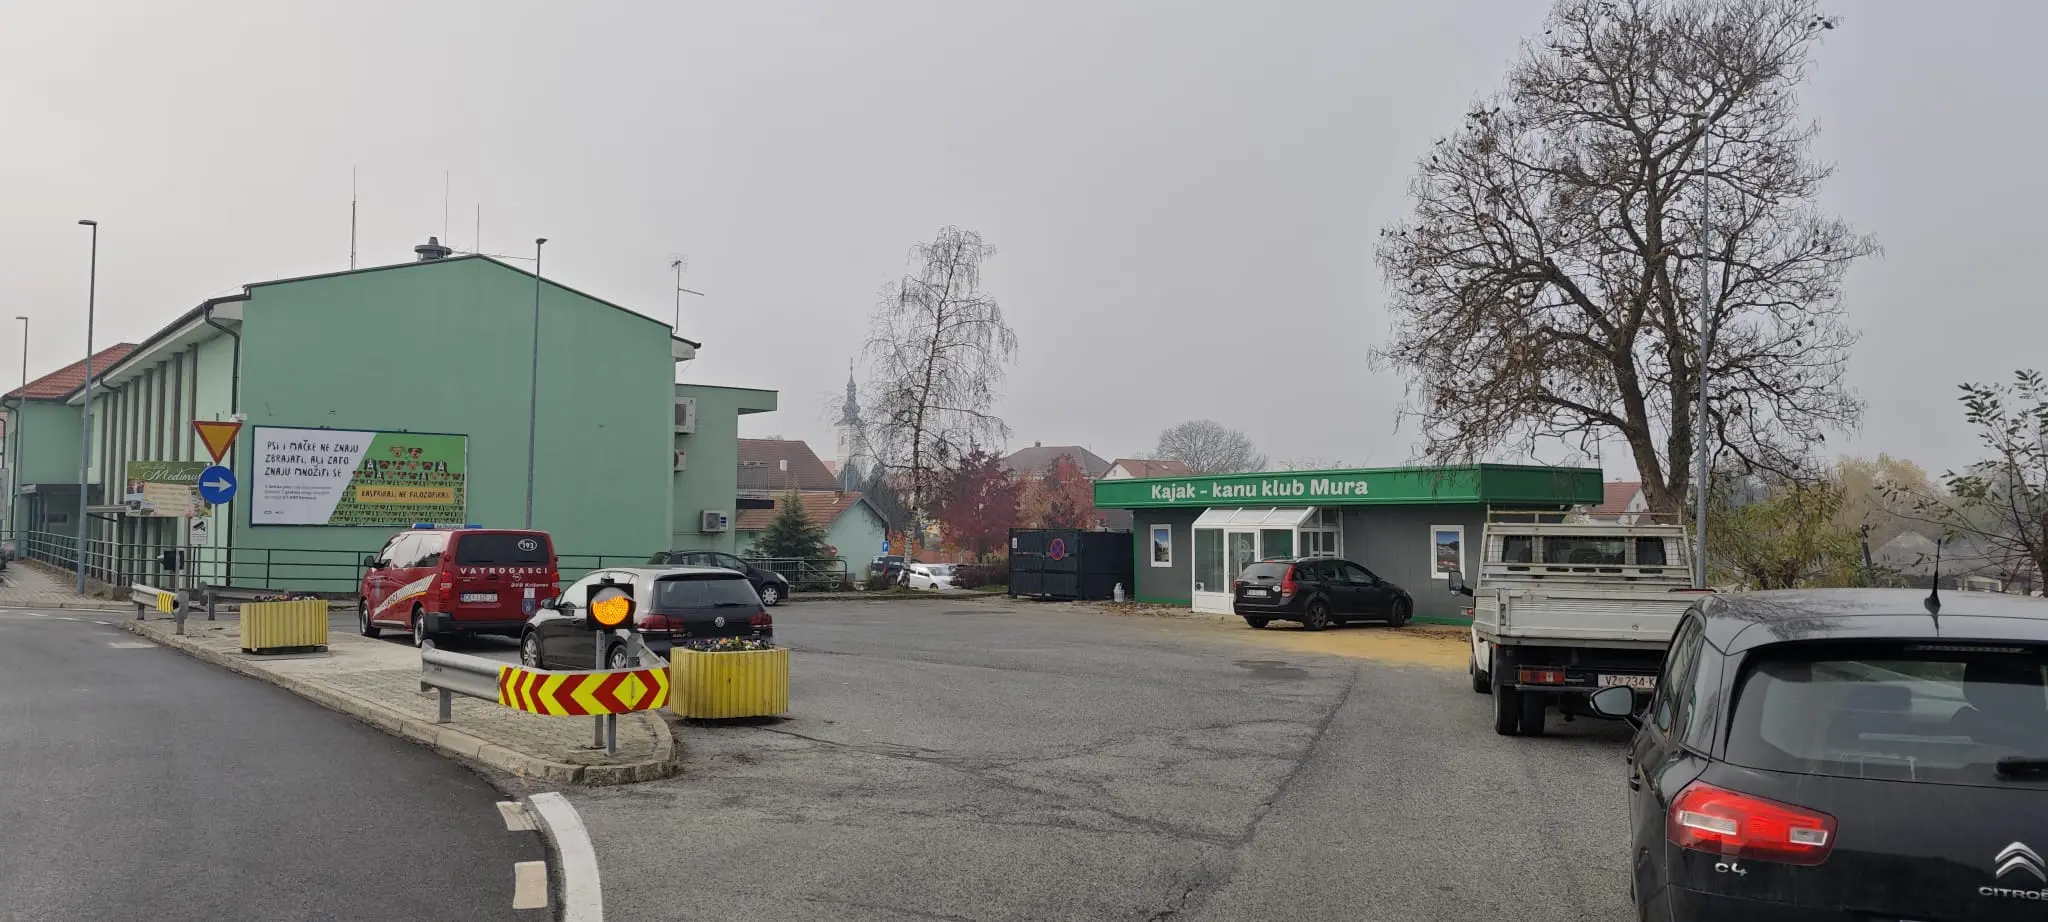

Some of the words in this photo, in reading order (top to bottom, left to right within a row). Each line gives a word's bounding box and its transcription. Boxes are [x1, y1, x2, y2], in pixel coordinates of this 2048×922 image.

[267, 441, 279, 450] PSI
[290, 440, 316, 451] MAČKE
[320, 443, 330, 452] NE
[334, 443, 358, 453] ZNAJU
[265, 454, 307, 464] ZBRAJATI,
[310, 455, 324, 465] ALI
[327, 456, 349, 465] ZATO
[264, 466, 291, 476] ZNAJU
[294, 464, 329, 477] MNOŽITI
[332, 468, 342, 477] SE
[399, 490, 407, 498] NE
[1151, 483, 1195, 501] Kajak
[1212, 482, 1257, 498] kanu
[1261, 480, 1304, 497] klub
[1310, 479, 1368, 496] Mura
[460, 567, 547, 575] VATROGASCI
[1605, 676, 1617, 686] VZ
